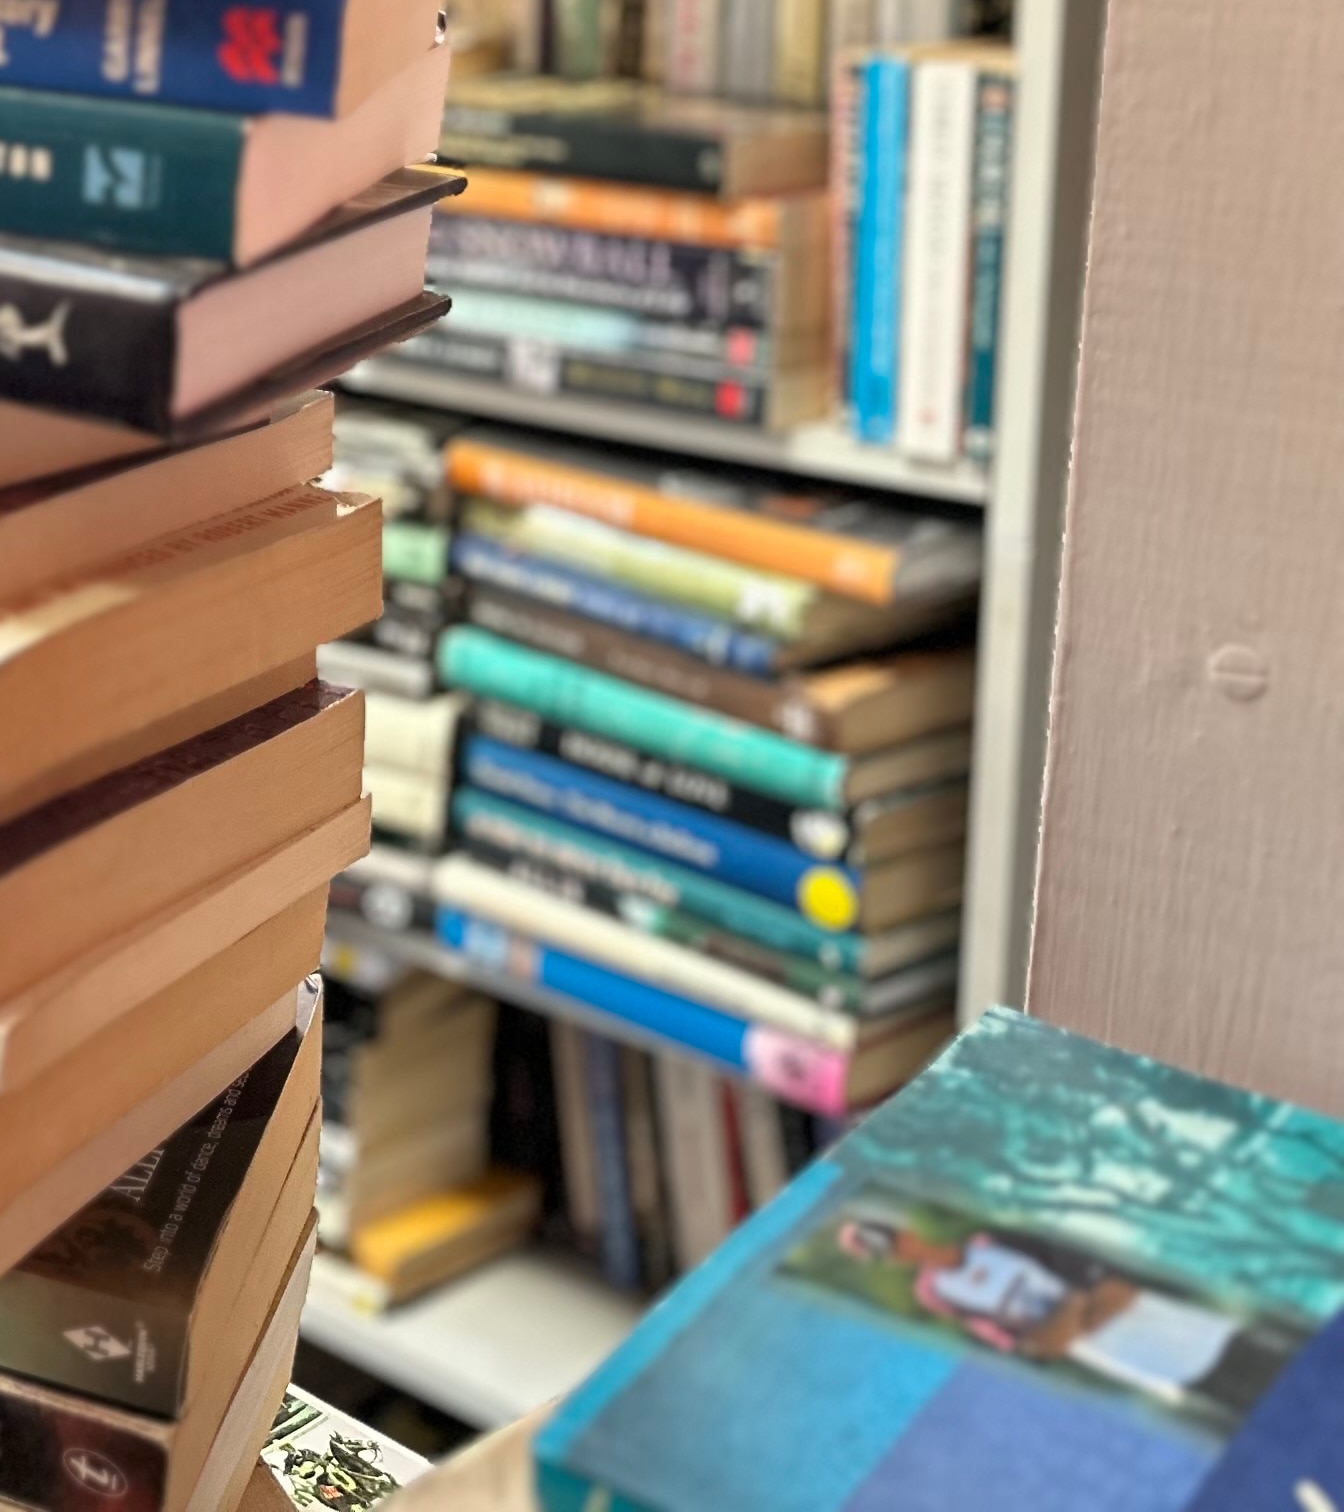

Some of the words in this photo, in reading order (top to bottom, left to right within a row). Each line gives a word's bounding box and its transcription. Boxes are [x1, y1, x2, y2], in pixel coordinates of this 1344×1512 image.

[143, 1241, 172, 1274] Step
[174, 1179, 198, 1214] world
[187, 1164, 203, 1183] of
[207, 1101, 233, 1140] dreams
